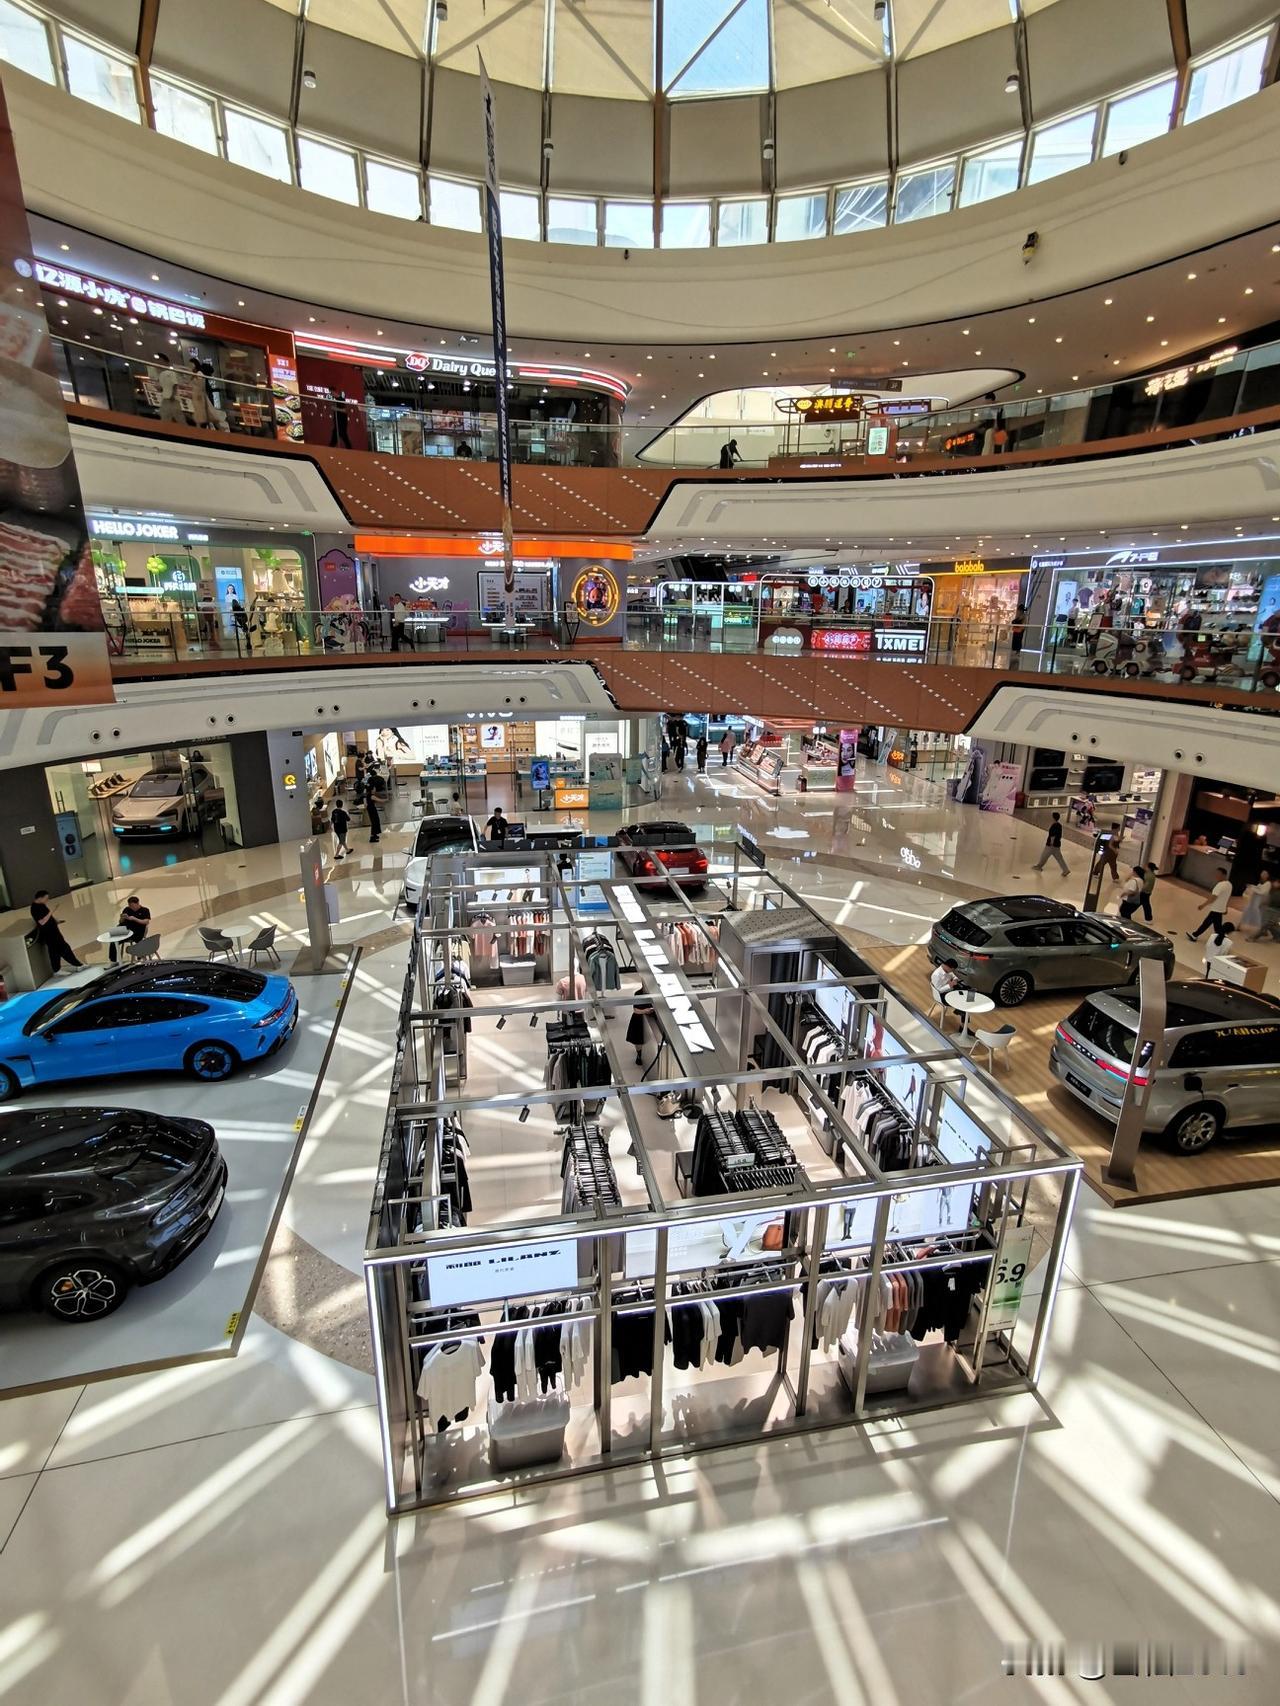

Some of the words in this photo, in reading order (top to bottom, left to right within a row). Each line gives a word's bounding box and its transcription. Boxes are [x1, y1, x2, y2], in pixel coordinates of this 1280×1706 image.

[431, 358, 469, 377] Dairy
[92, 519, 135, 535] HELLO
[135, 523, 179, 539] JOKER
[0, 646, 75, 692] F3
[632, 929, 716, 1054] LILANZ
[488, 1249, 562, 1265] LILANZ
